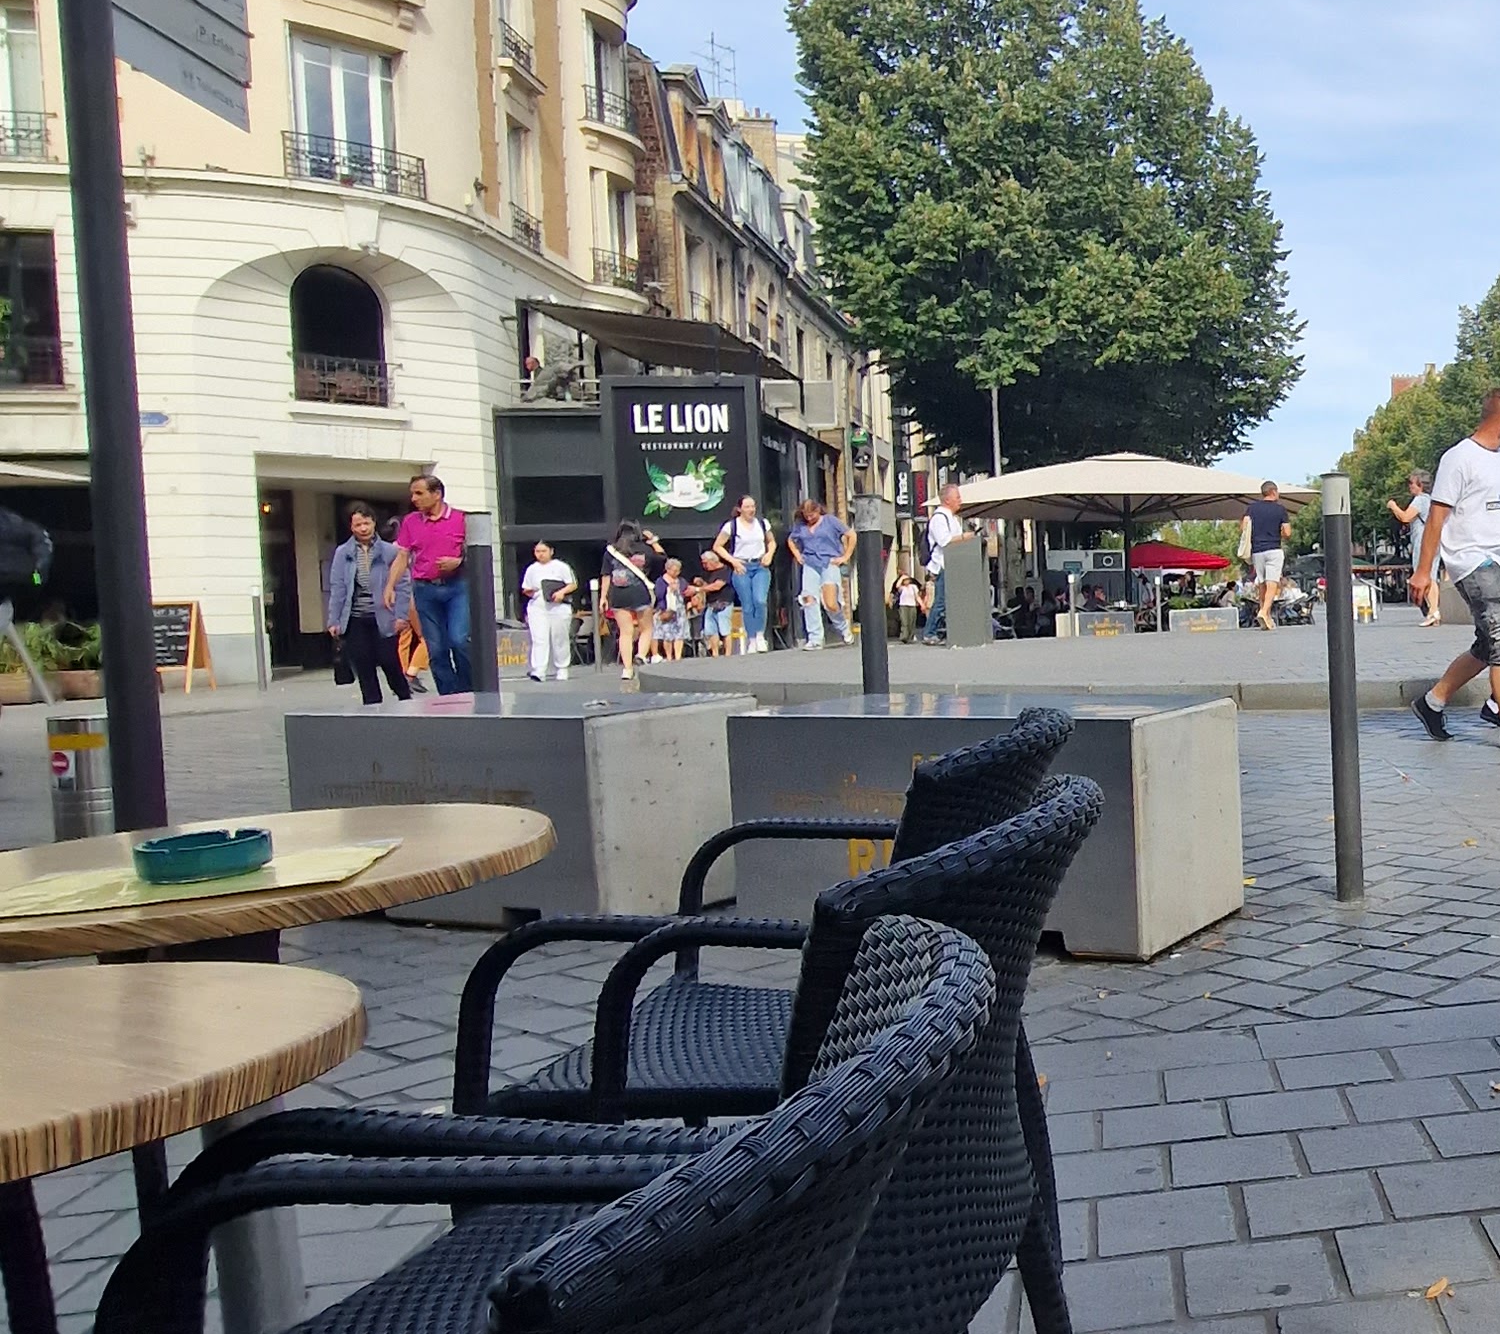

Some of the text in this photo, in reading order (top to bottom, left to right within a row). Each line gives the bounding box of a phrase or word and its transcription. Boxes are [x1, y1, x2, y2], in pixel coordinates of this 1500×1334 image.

[631, 403, 729, 433] LE LION
[641, 441, 694, 451] RESTAURANT
[896, 471, 909, 506] fnac
[497, 654, 528, 665] EIMS
